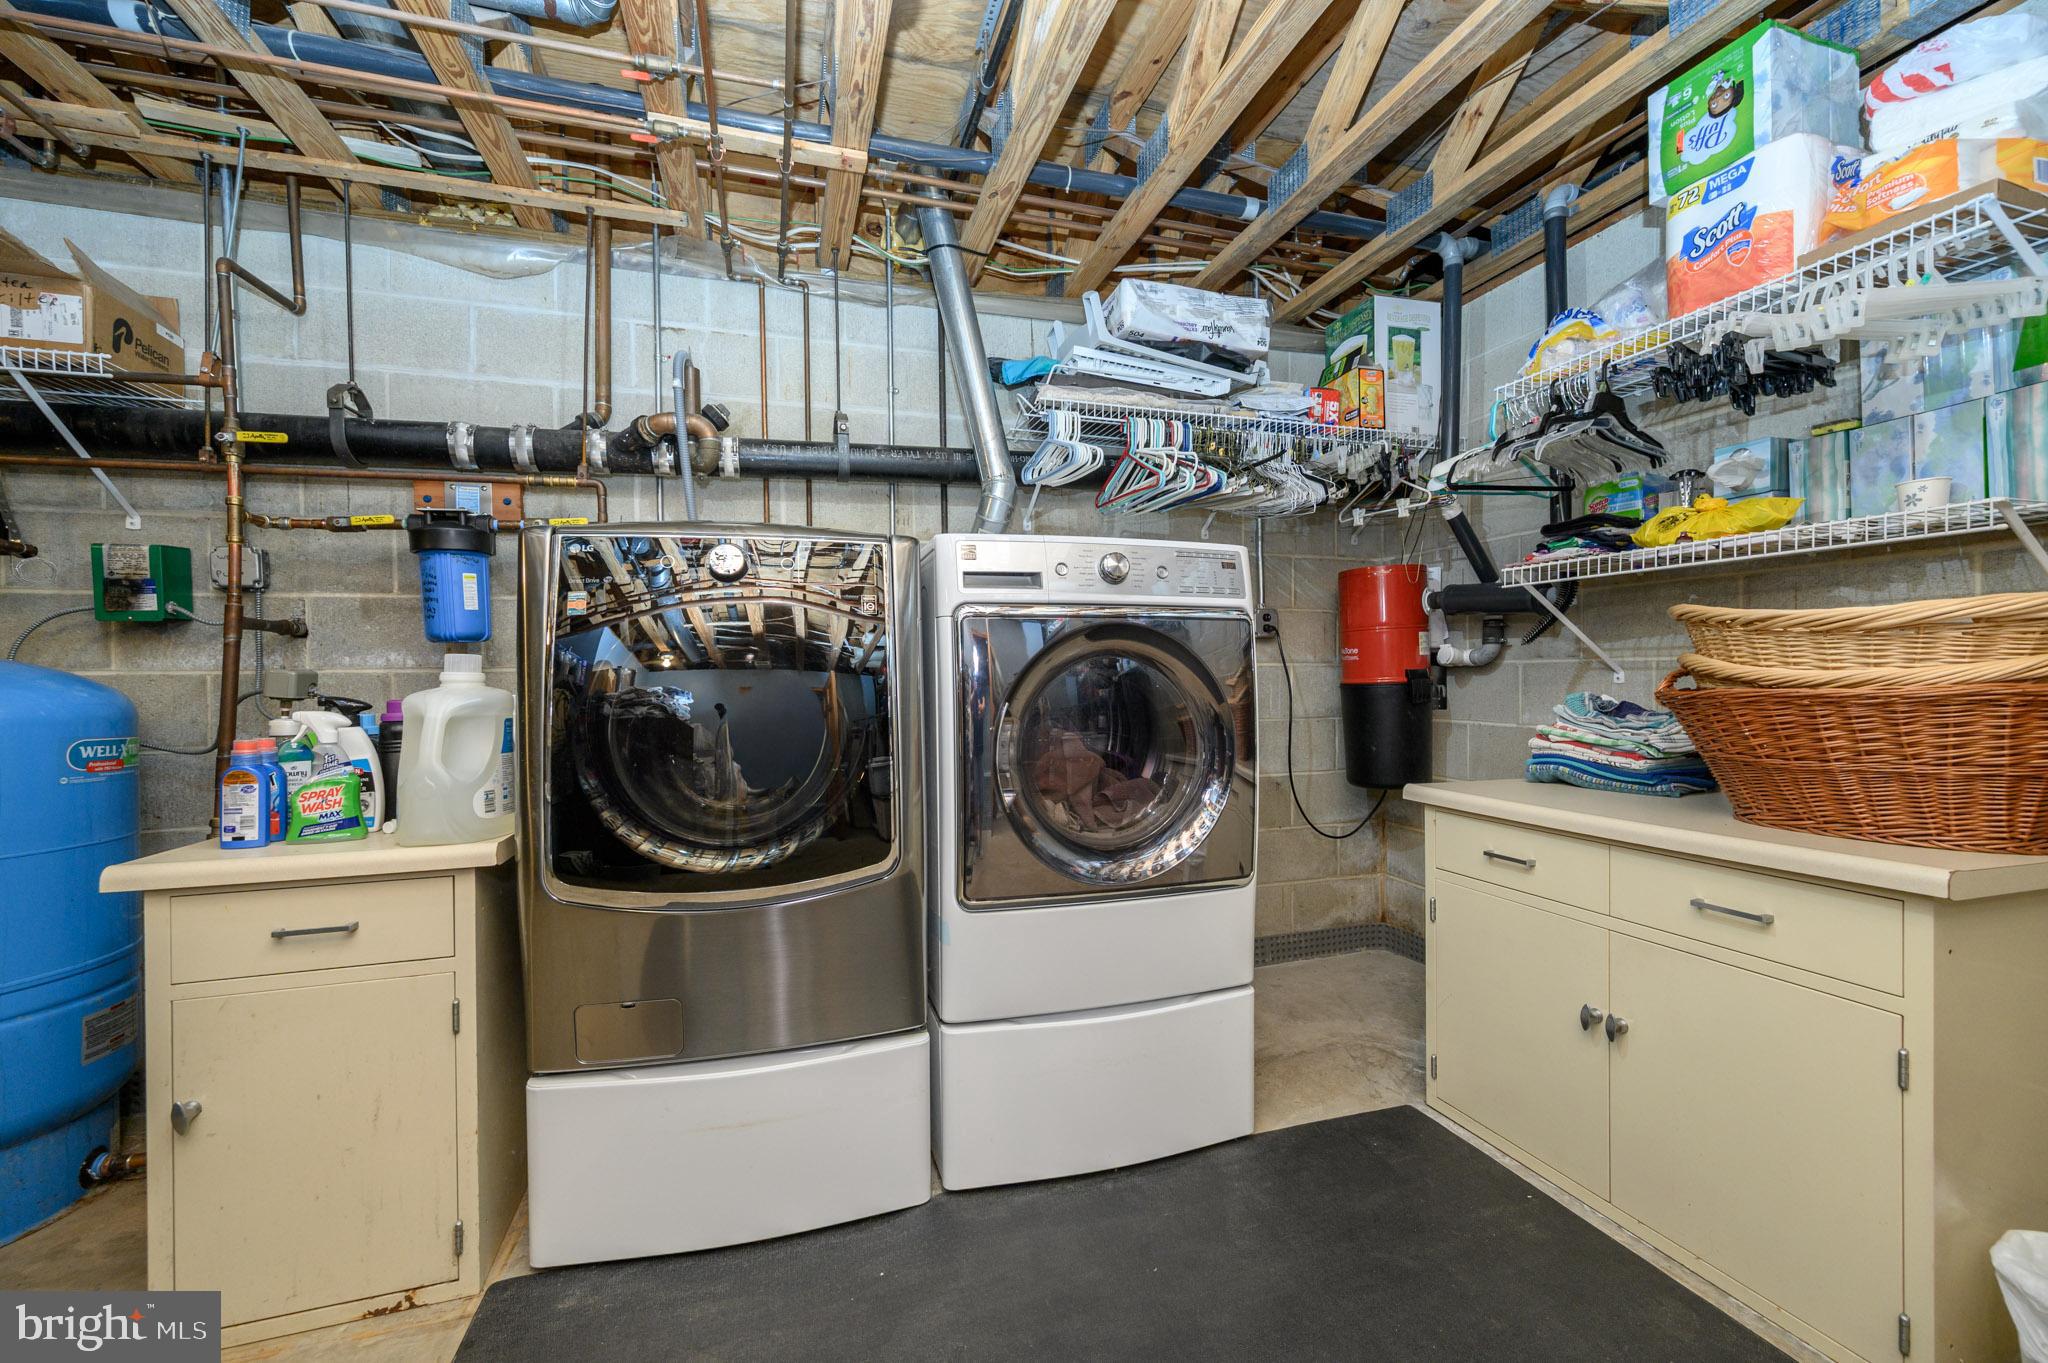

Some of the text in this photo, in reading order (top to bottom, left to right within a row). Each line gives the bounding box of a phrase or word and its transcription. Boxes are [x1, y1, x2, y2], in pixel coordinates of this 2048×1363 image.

[1688, 114, 1728, 152] Puffs
[1708, 165, 1747, 191] MEGA
[1835, 159, 1861, 181] Scott
[1867, 174, 1915, 198] Premium
[1867, 182, 1914, 207] Softness
[1678, 187, 1700, 209] 72
[1689, 201, 1745, 258] Scott
[1692, 246, 1725, 271] Comfort
[1724, 232, 1744, 248] Plus
[135, 337, 170, 367] Pelican
[582, 544, 594, 552] LG
[586, 576, 600, 584] Drive
[298, 784, 344, 804] SPRAY
[301, 796, 344, 815] WASH
[318, 810, 343, 821] MAX
